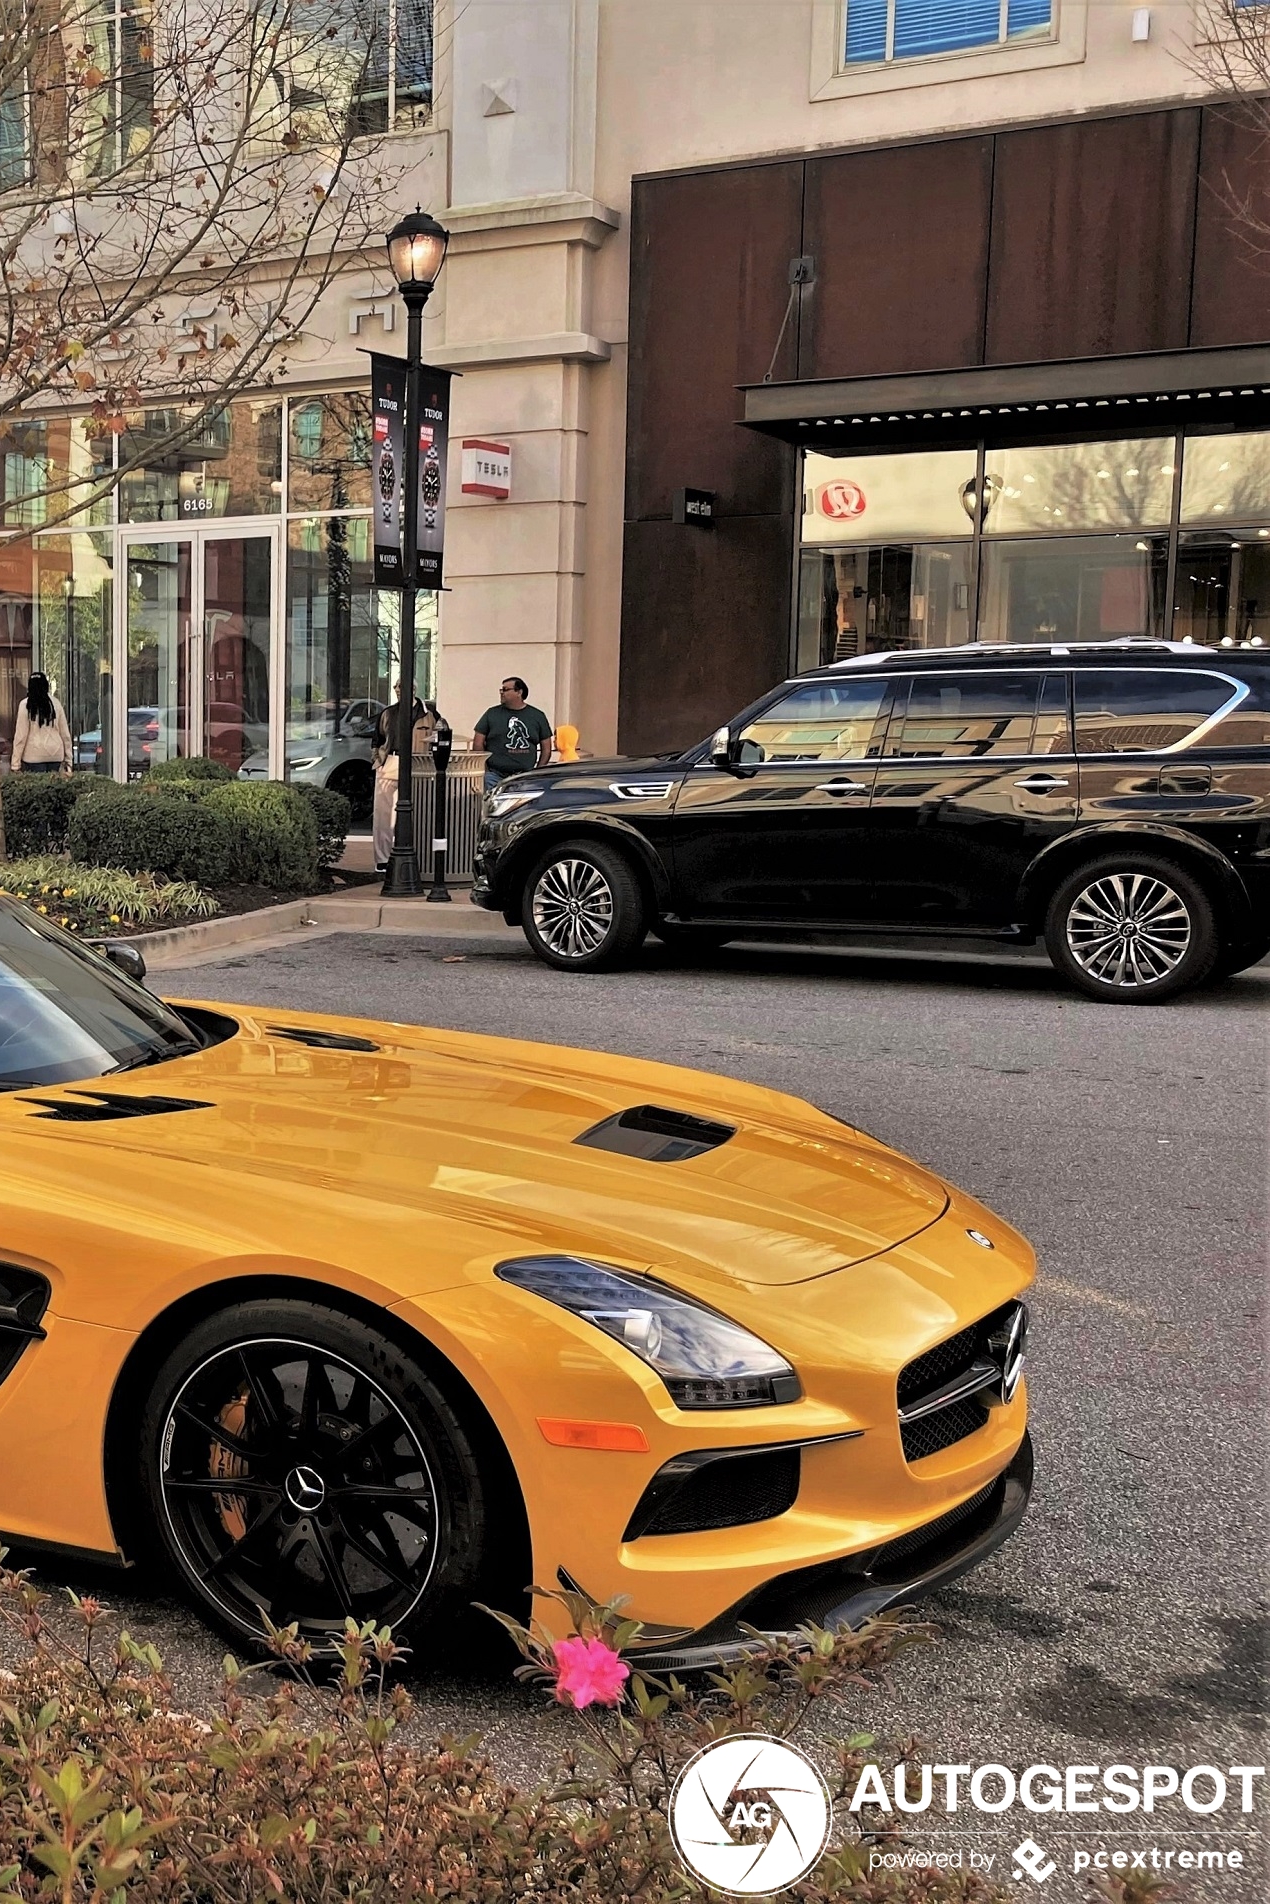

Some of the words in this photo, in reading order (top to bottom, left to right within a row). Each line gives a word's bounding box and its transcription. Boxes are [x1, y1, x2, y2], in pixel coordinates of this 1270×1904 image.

[378, 397, 398, 411] TUDOR
[424, 408, 443, 420] TUDOR
[477, 461, 509, 477] TESLA
[183, 498, 213, 511] 6165
